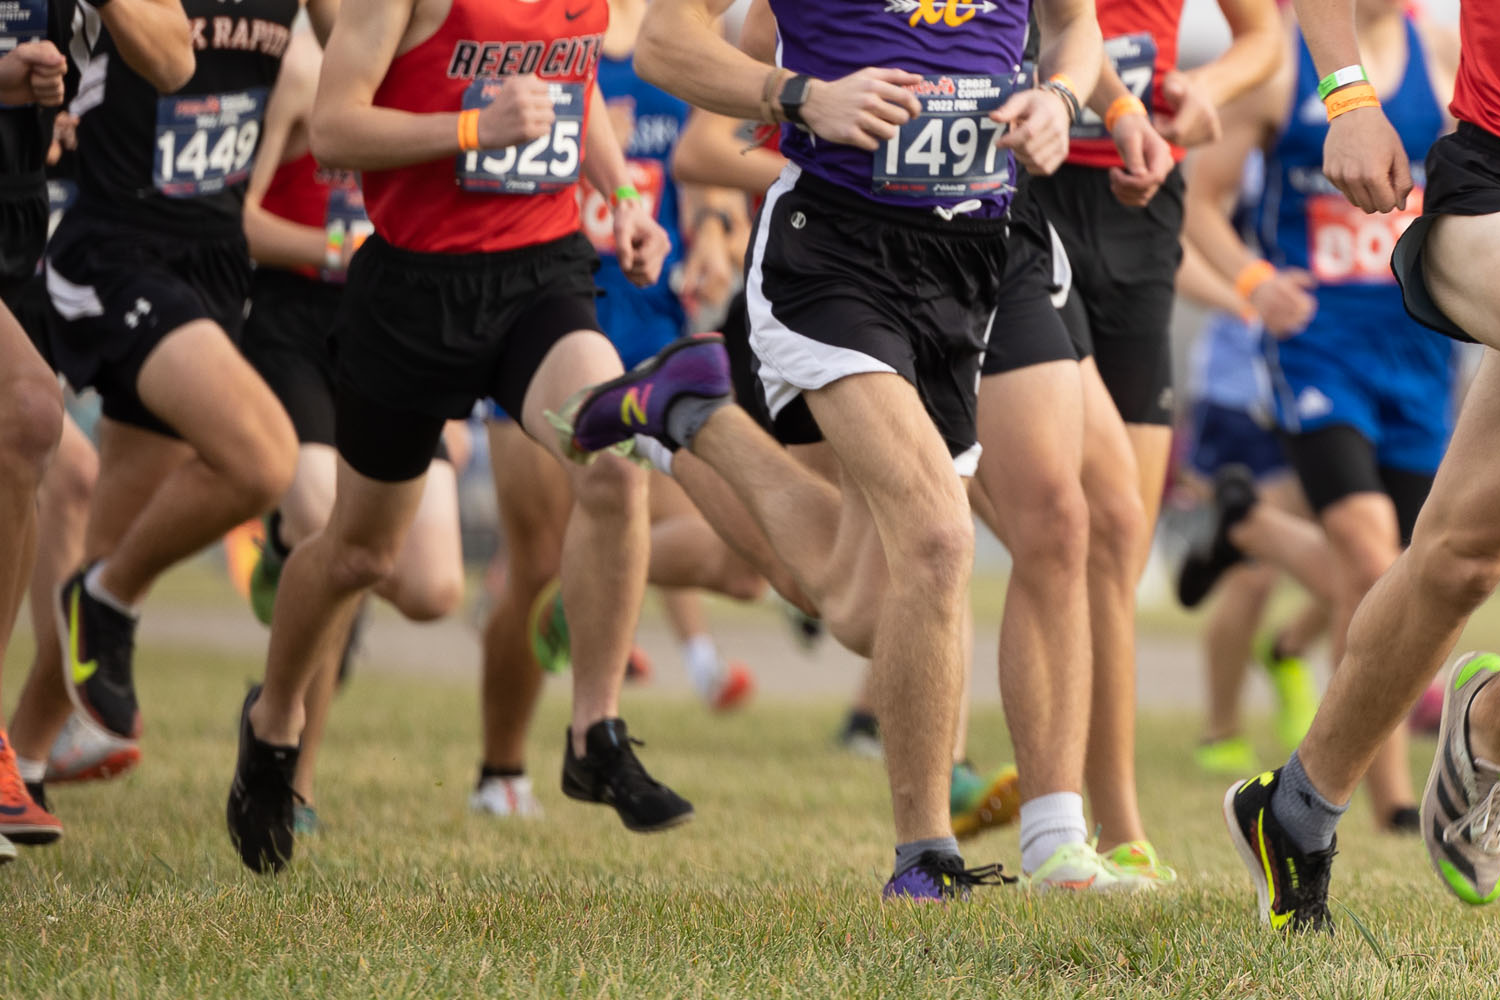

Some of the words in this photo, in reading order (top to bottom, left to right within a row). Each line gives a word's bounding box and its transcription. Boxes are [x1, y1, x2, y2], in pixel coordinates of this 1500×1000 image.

[447, 39, 546, 80] REED
[957, 78, 992, 89] CROSS
[957, 87, 1001, 99] COUNTRY
[927, 99, 953, 112] 2022
[954, 99, 978, 112] FINAL
[157, 119, 259, 182] 1449
[886, 117, 1006, 177] 1497
[1316, 215, 1414, 276] 80
